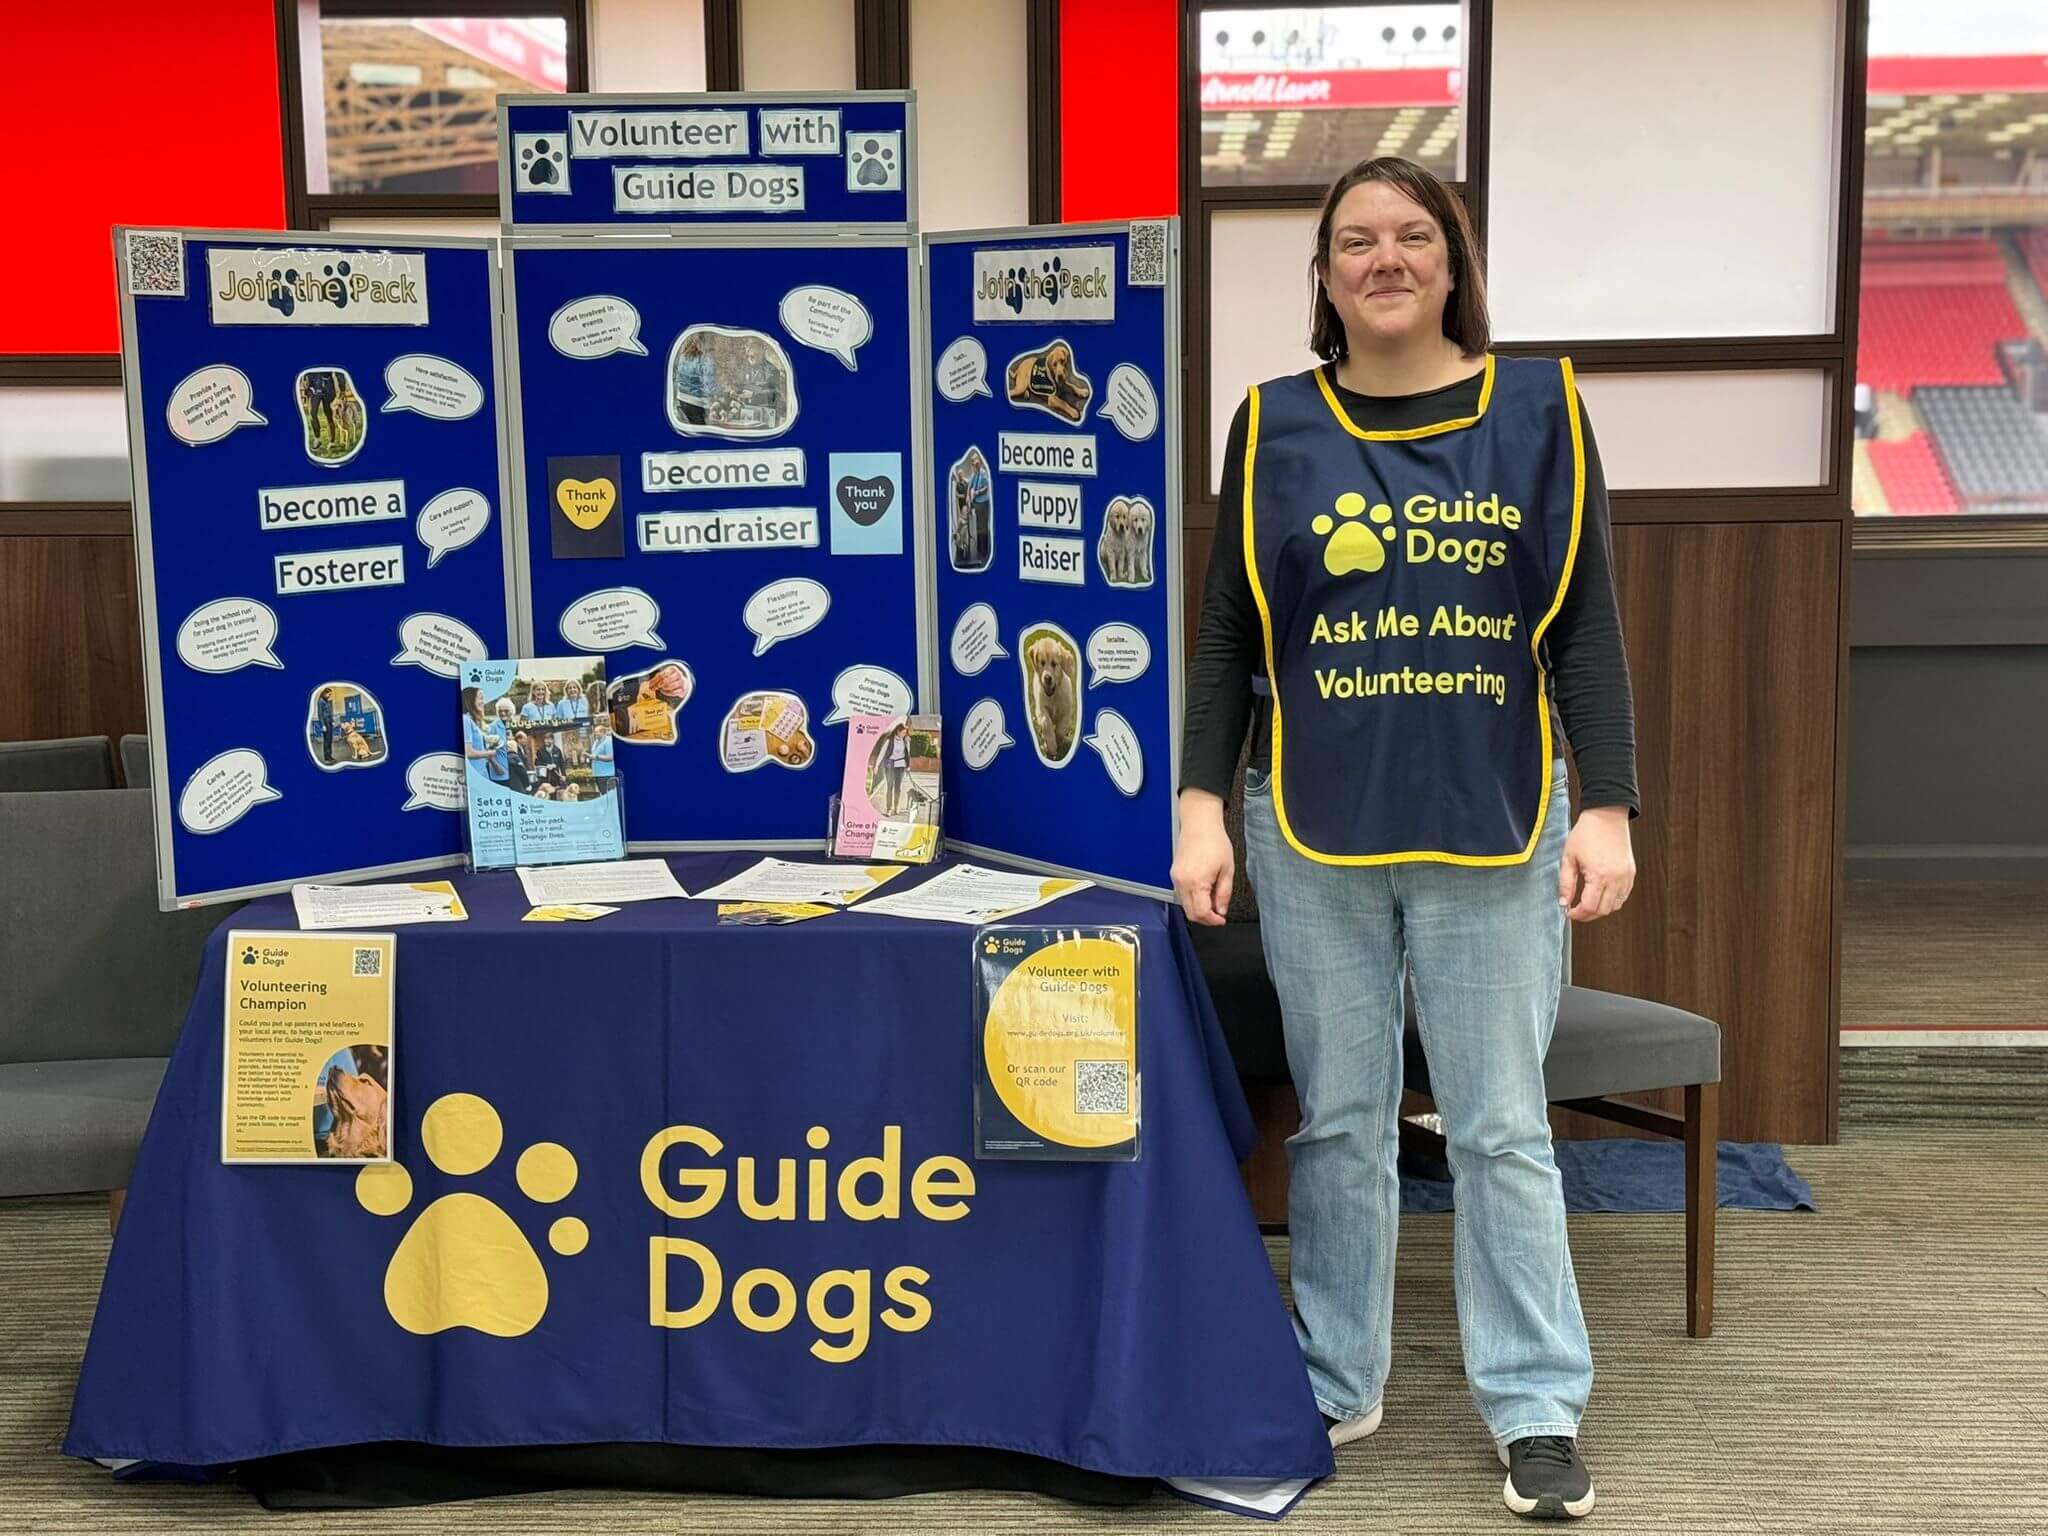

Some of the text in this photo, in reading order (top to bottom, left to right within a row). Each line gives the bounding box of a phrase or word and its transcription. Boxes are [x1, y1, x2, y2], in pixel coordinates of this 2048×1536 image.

[576, 117, 836, 146] Volunteer with
[623, 172, 799, 204] Guide Dogs
[219, 271, 418, 303] Join the Pack
[977, 268, 1108, 300] Join the Pack
[567, 315, 579, 323] Get
[809, 306, 845, 323] Community
[582, 318, 603, 328] events
[190, 385, 212, 401] Provide
[205, 410, 229, 426] training
[1001, 439, 1093, 469] become a
[648, 459, 799, 486] become a
[566, 490, 607, 501] Thank
[845, 486, 886, 498] Thank
[265, 493, 401, 523] become a
[429, 499, 473, 521] Care and support
[575, 503, 598, 515] you
[854, 500, 878, 511] you
[1020, 488, 1078, 524] Puppy
[1404, 491, 1522, 530] Guide
[645, 518, 813, 546] Fundraiser
[1023, 542, 1081, 571] Raiser
[1407, 529, 1507, 574] Dogs
[279, 558, 399, 588] Fosterer
[583, 606, 599, 615] Type
[609, 600, 630, 609] events
[194, 620, 209, 628] Doing
[203, 627, 214, 636] your
[1310, 605, 1516, 644] Ask Me About
[1315, 665, 1505, 705] Volunteering
[877, 689, 890, 698] Dogs
[477, 798, 493, 807] Set
[478, 809, 499, 818] Join
[478, 820, 512, 830] Chang
[846, 821, 864, 829] Give
[1003, 938, 1026, 946] Guide
[263, 949, 289, 957] Guide
[1003, 946, 1023, 954] Dogs
[263, 958, 285, 967] Dogs
[1028, 966, 1120, 977] Volunteer with
[241, 980, 327, 995] Volunteering
[1040, 982, 1108, 994] Guide Dogs
[240, 998, 307, 1012] Champion
[1008, 1064, 1022, 1073] Or
[1016, 1077, 1058, 1087] QR code
[640, 1124, 976, 1222] Guide
[649, 1236, 933, 1363] Dogs
